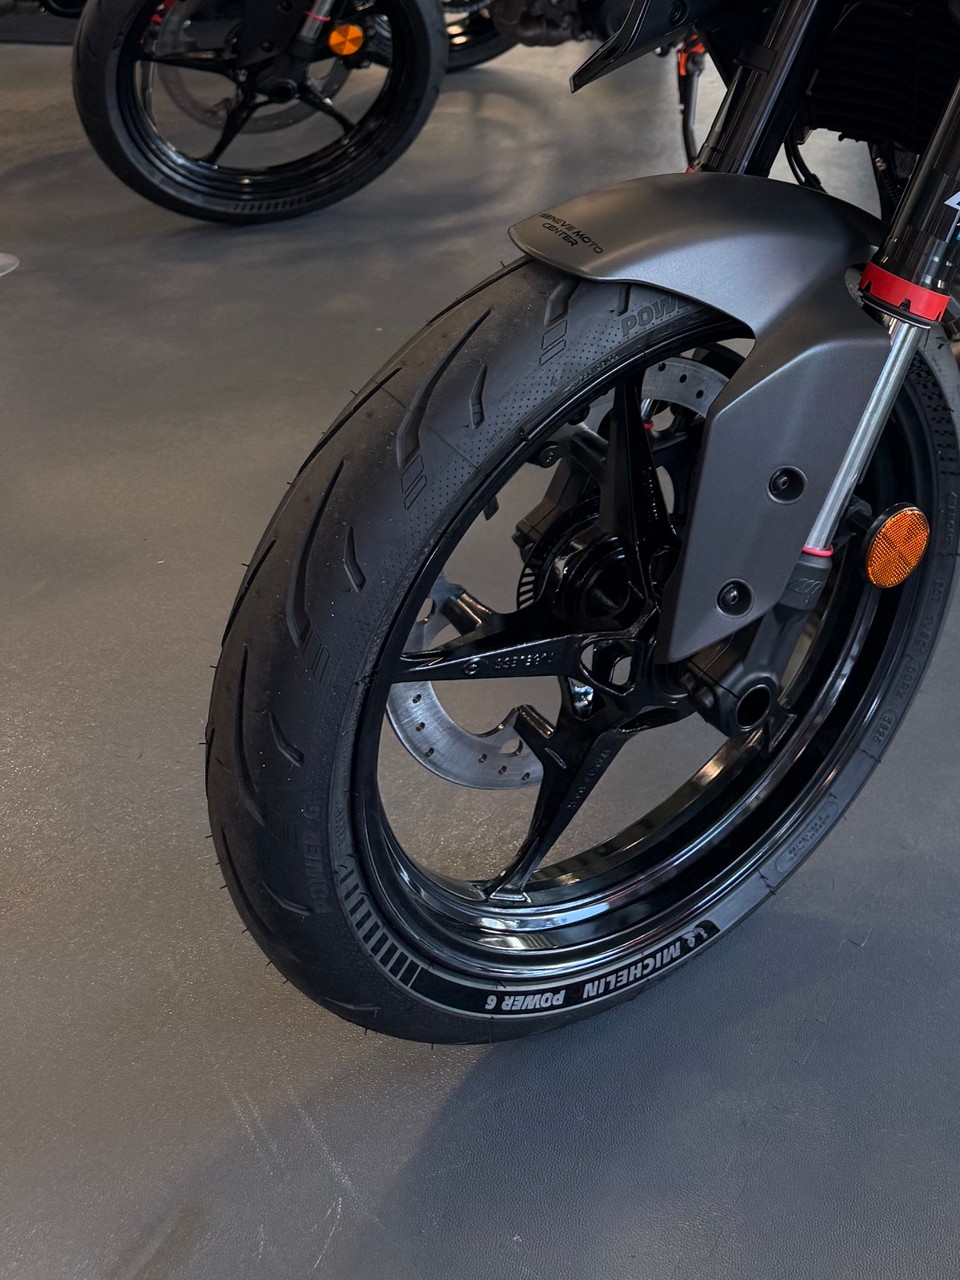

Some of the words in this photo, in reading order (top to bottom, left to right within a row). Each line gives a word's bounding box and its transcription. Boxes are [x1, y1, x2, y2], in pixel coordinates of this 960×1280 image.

[539, 212, 573, 232] GENEVE
[572, 230, 604, 254] MOTO
[542, 222, 579, 247] CENTER
[583, 941, 683, 1000] MICHELIN
[485, 994, 498, 1010] 6
[501, 989, 566, 1011] POWER
